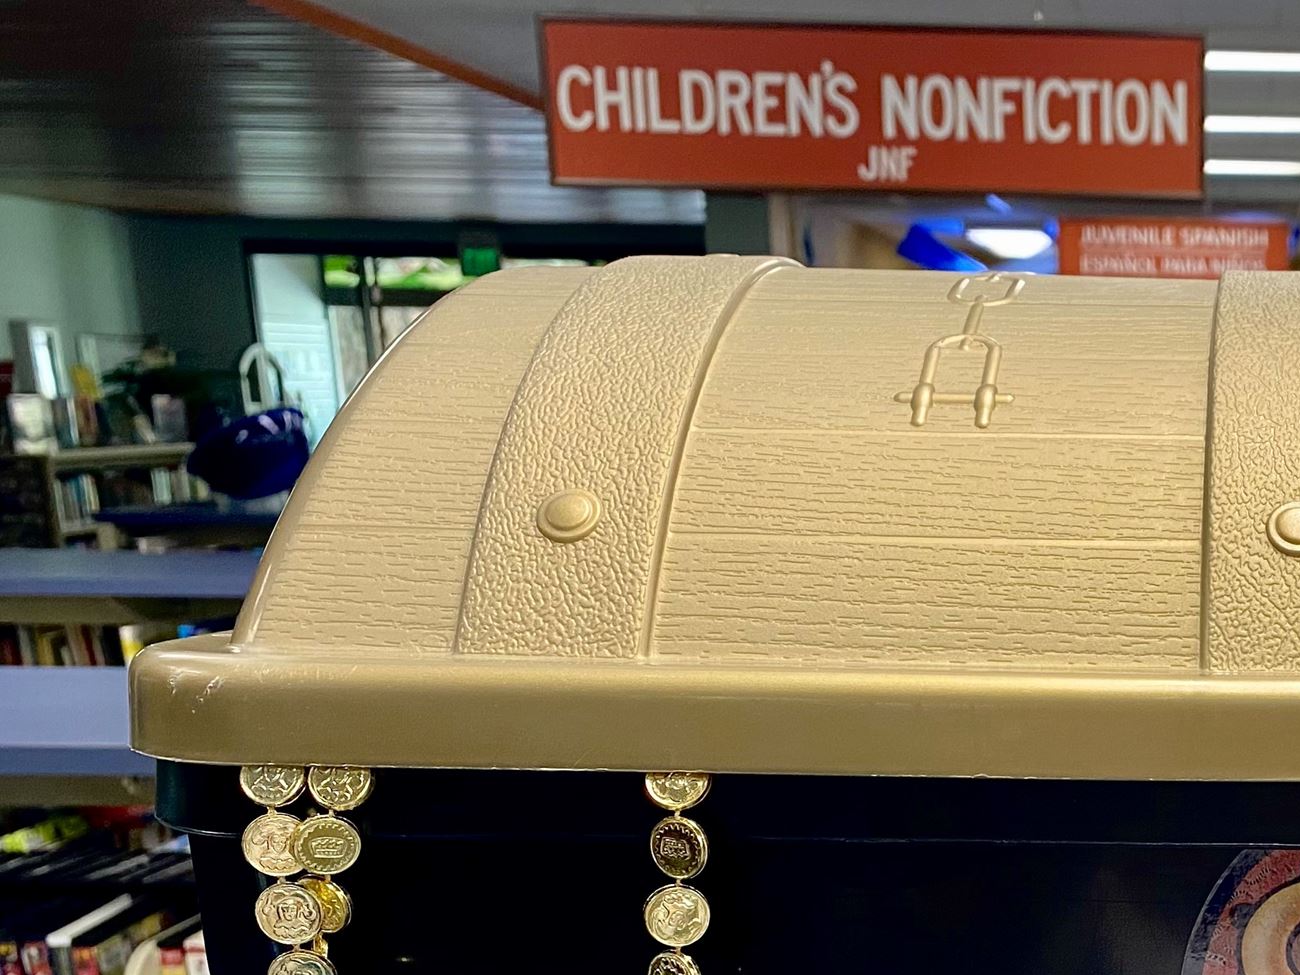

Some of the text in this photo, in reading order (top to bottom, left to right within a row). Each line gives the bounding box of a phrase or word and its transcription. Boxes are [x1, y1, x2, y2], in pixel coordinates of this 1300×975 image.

[556, 60, 1188, 146] CHILDREN'S NONFICTION
[857, 146, 917, 181] JNF
[1082, 225, 1268, 248] JUVENILE SPANISH
[1160, 254, 1207, 275] PARA
